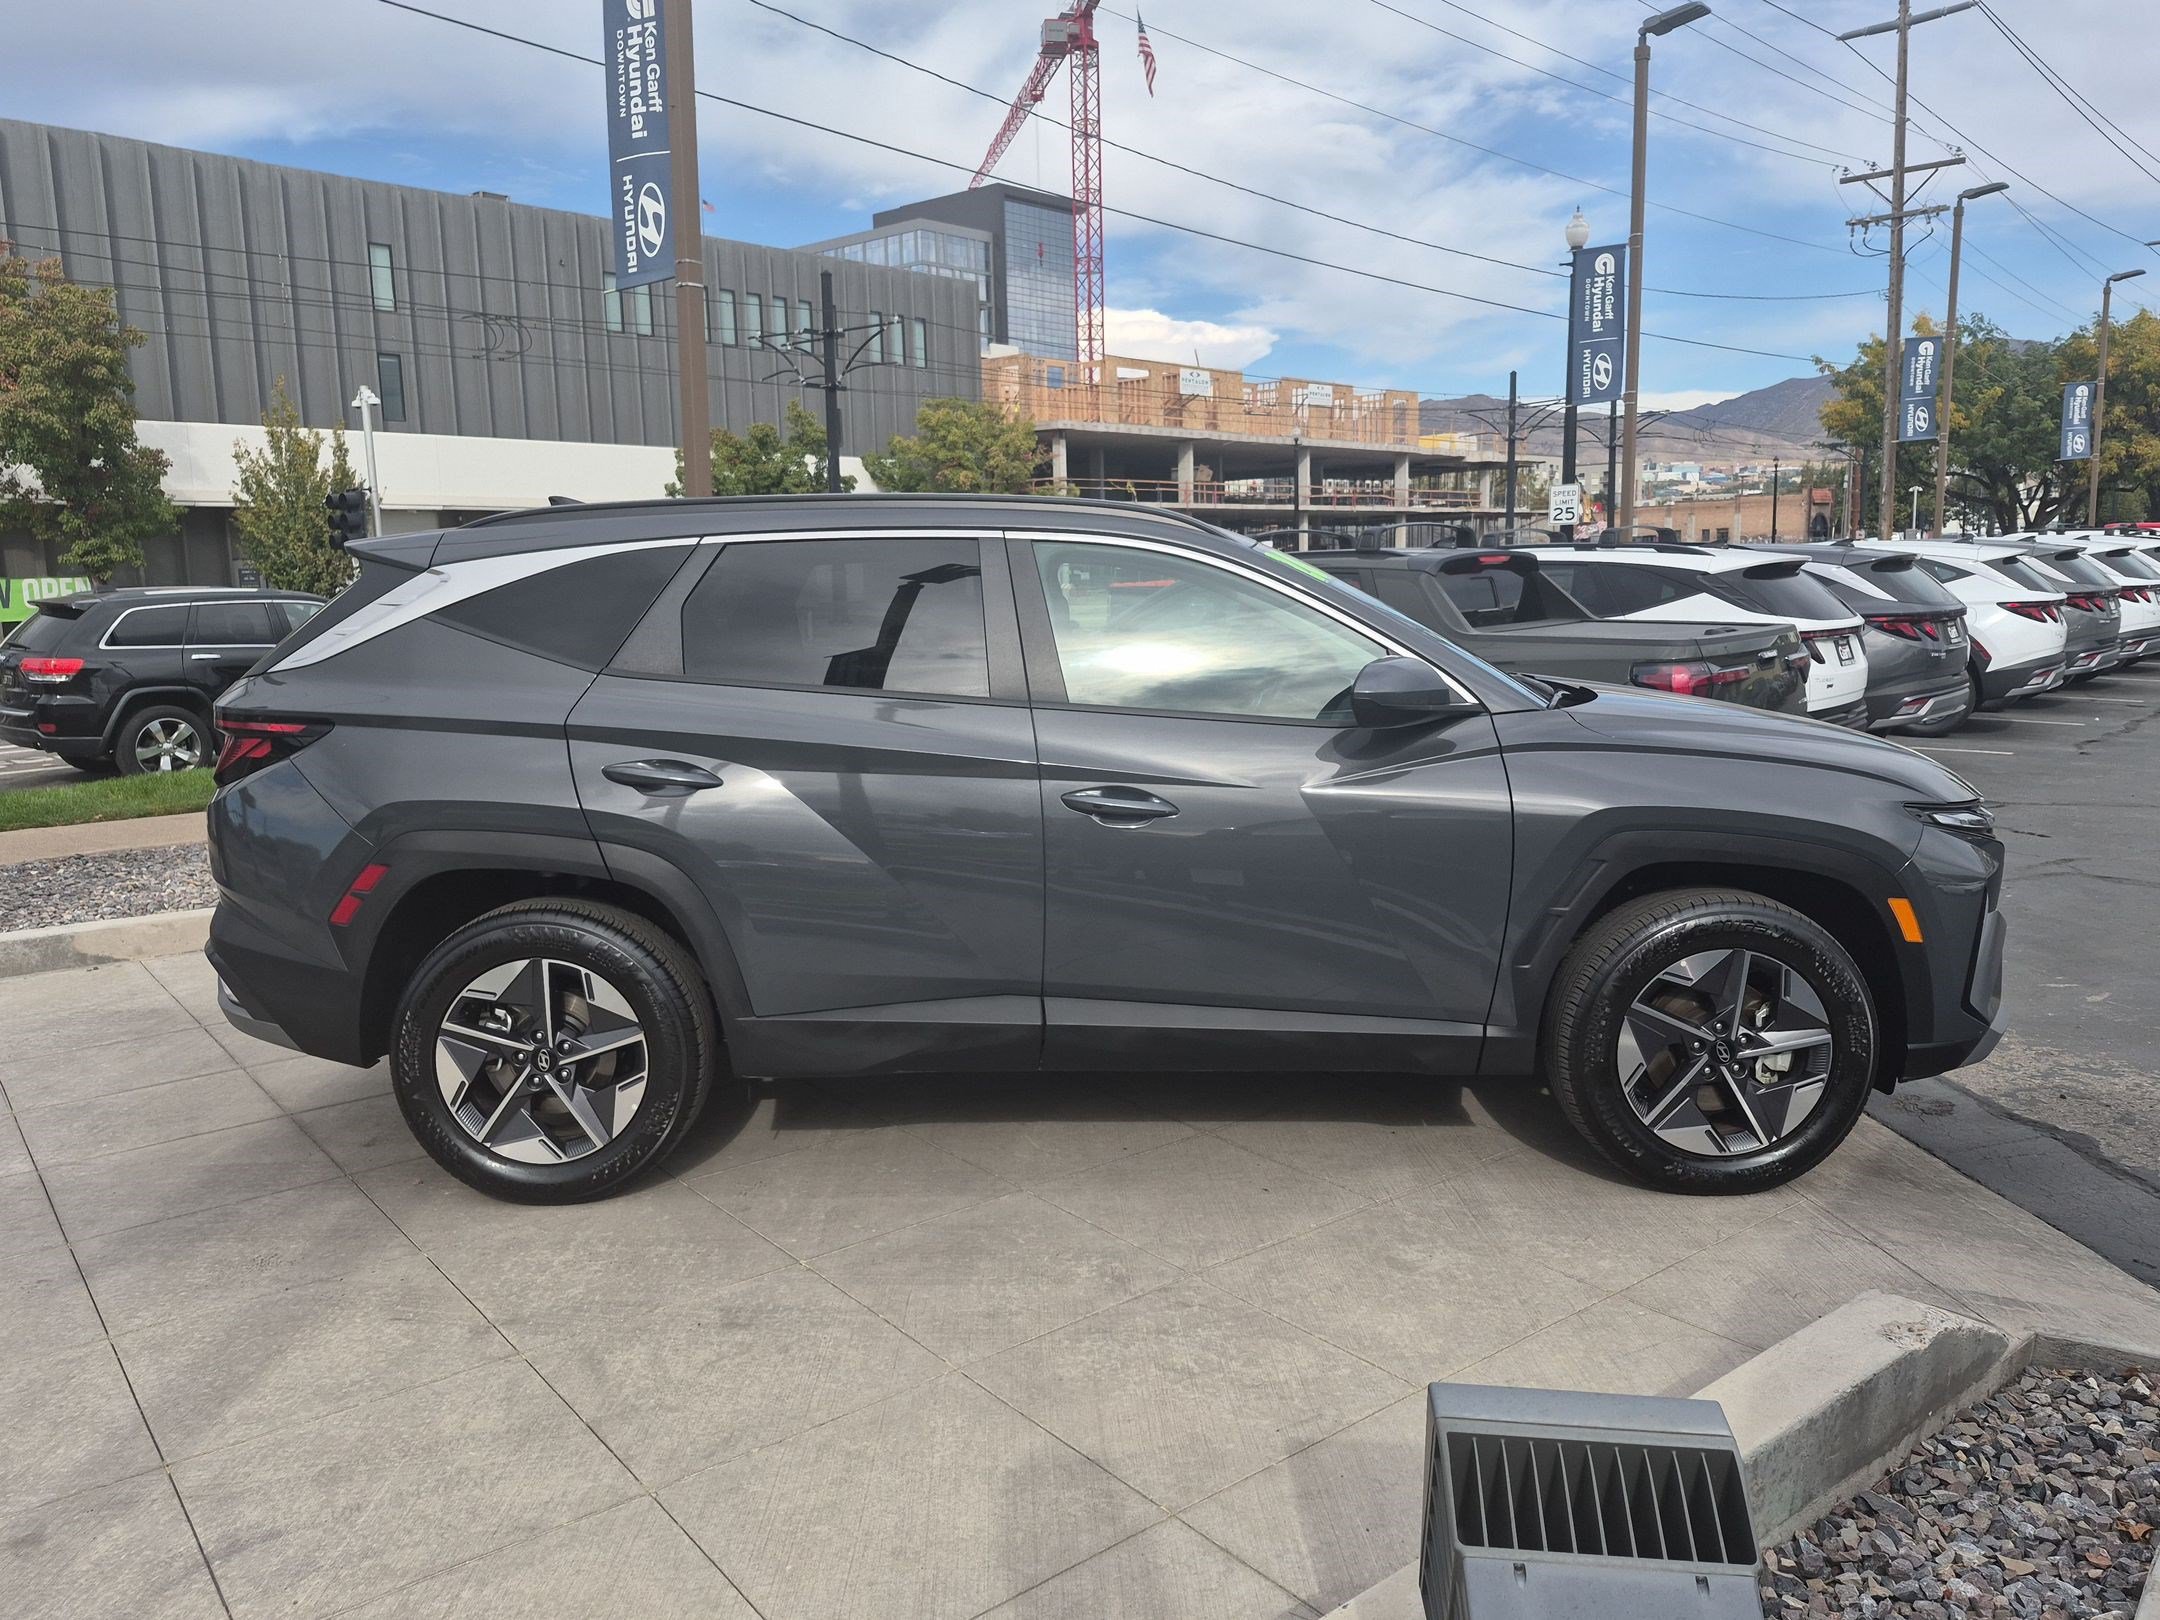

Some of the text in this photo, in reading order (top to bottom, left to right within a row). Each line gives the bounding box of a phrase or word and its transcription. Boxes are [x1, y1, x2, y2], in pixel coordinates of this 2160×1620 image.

[616, 29, 627, 118] DOWNTOWN
[625, 24, 648, 140] Hyundai
[644, 20, 663, 113] Ken Garff
[622, 174, 638, 274] HYUNDAI
[1584, 278, 1592, 322] DOWNTOWN
[1592, 276, 1605, 333] Hyundai
[1604, 275, 1616, 320] Ken Garff
[1582, 349, 1592, 398] HYUNDAI
[1915, 356, 1926, 393] Hyundai
[1907, 403, 1915, 437] HYUNDAI
[1553, 507, 1575, 521] 25
